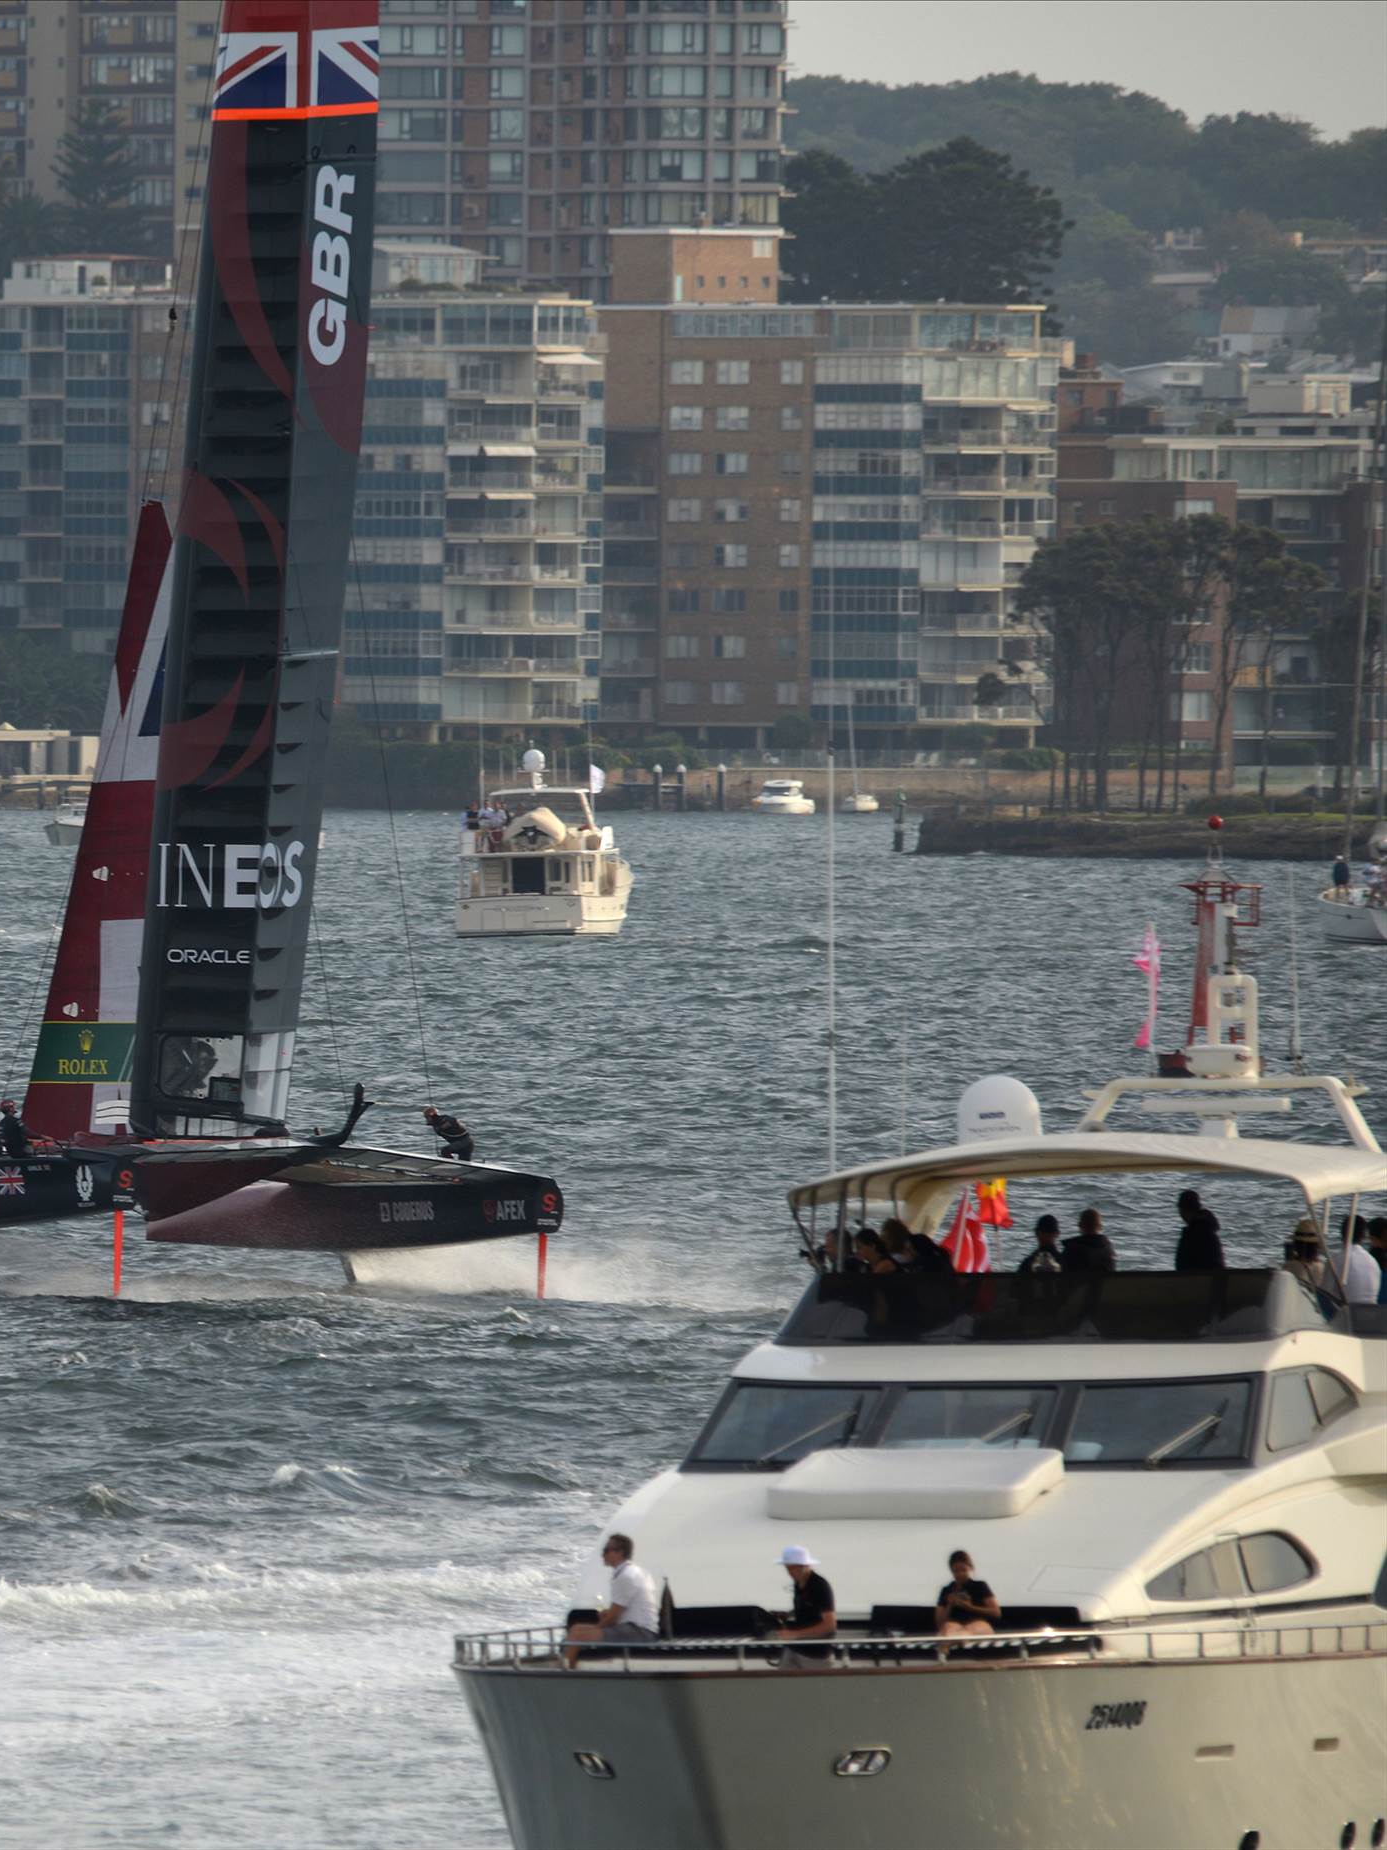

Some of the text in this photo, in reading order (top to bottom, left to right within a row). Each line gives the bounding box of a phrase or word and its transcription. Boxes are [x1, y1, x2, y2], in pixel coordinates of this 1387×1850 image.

[308, 165, 356, 366] GBR
[156, 840, 305, 909] INEOS
[167, 949, 251, 964] ORACLE
[58, 1059, 108, 1075] ROLEX
[496, 1200, 526, 1221] AFEX
